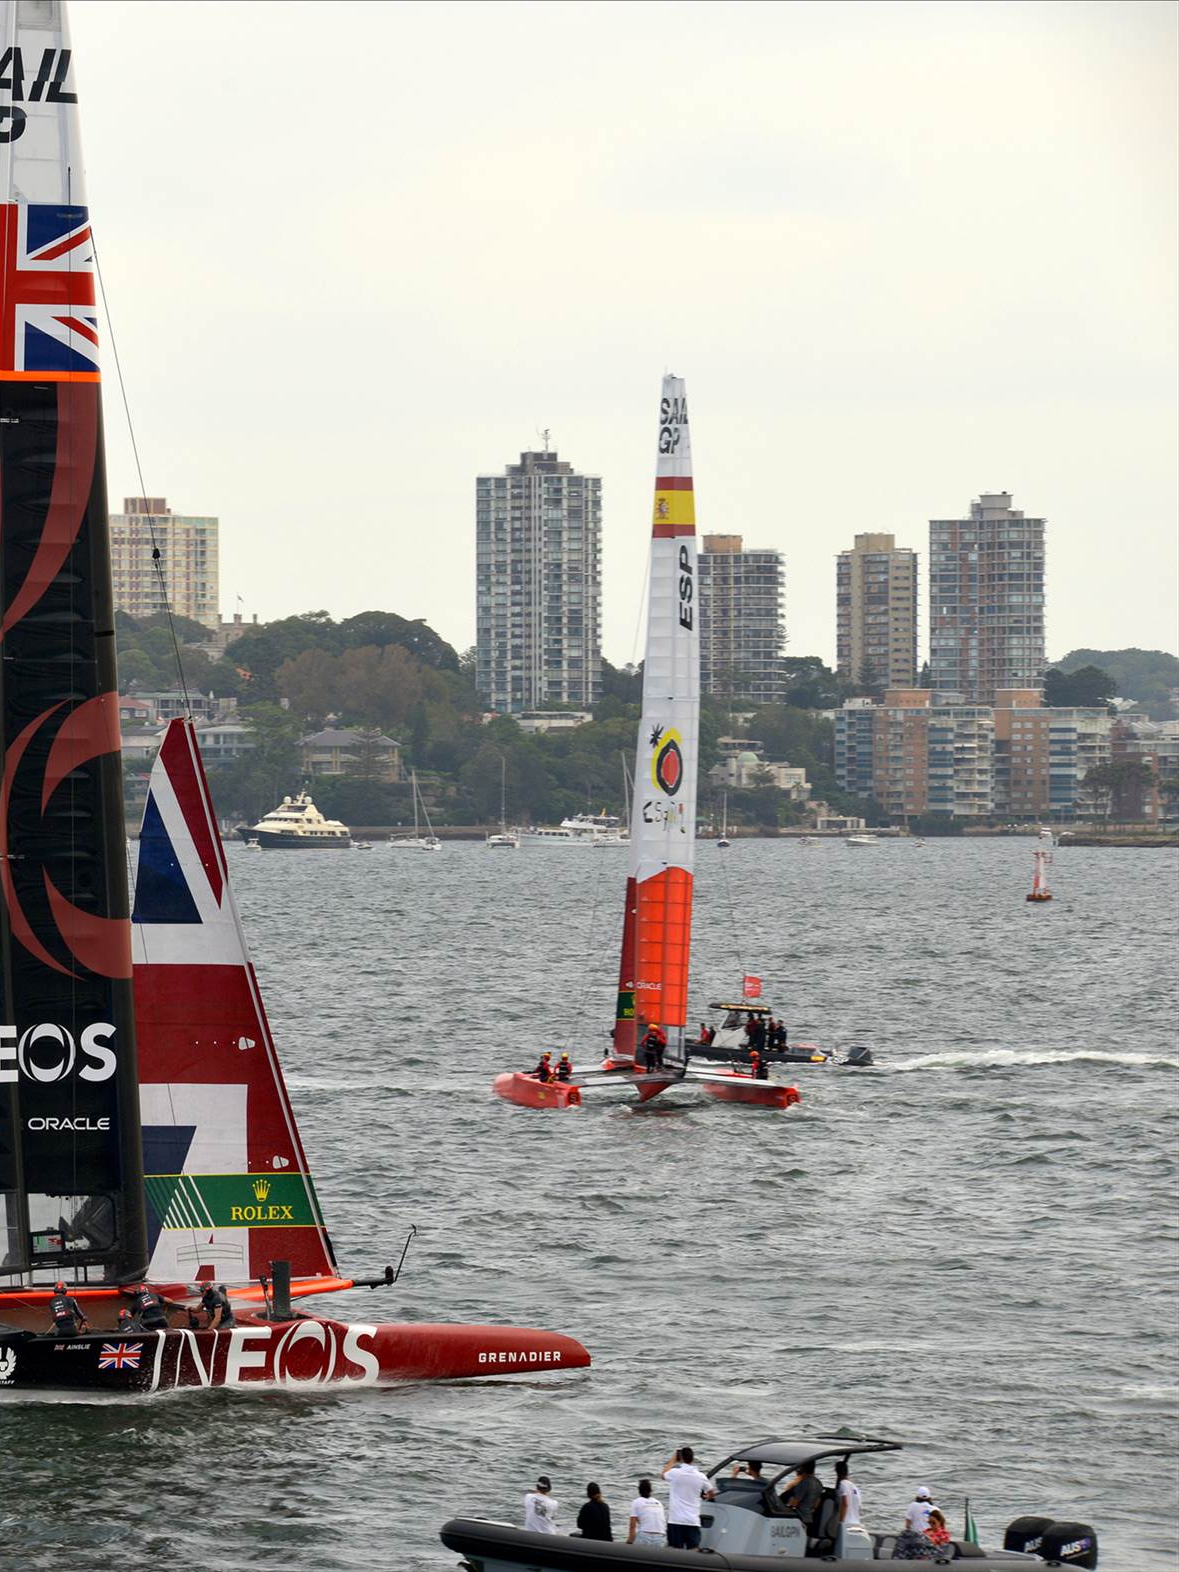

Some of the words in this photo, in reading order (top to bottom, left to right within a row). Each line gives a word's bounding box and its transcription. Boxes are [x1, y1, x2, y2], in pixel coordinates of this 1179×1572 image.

[660, 398, 689, 425] SAIL
[659, 427, 681, 454] GP
[679, 544, 693, 631] ESP
[28, 1117, 111, 1131] ORACLE
[231, 1205, 294, 1221] ROLEX
[149, 1321, 380, 1393] INEOS
[478, 1351, 562, 1363] GRENADIER
